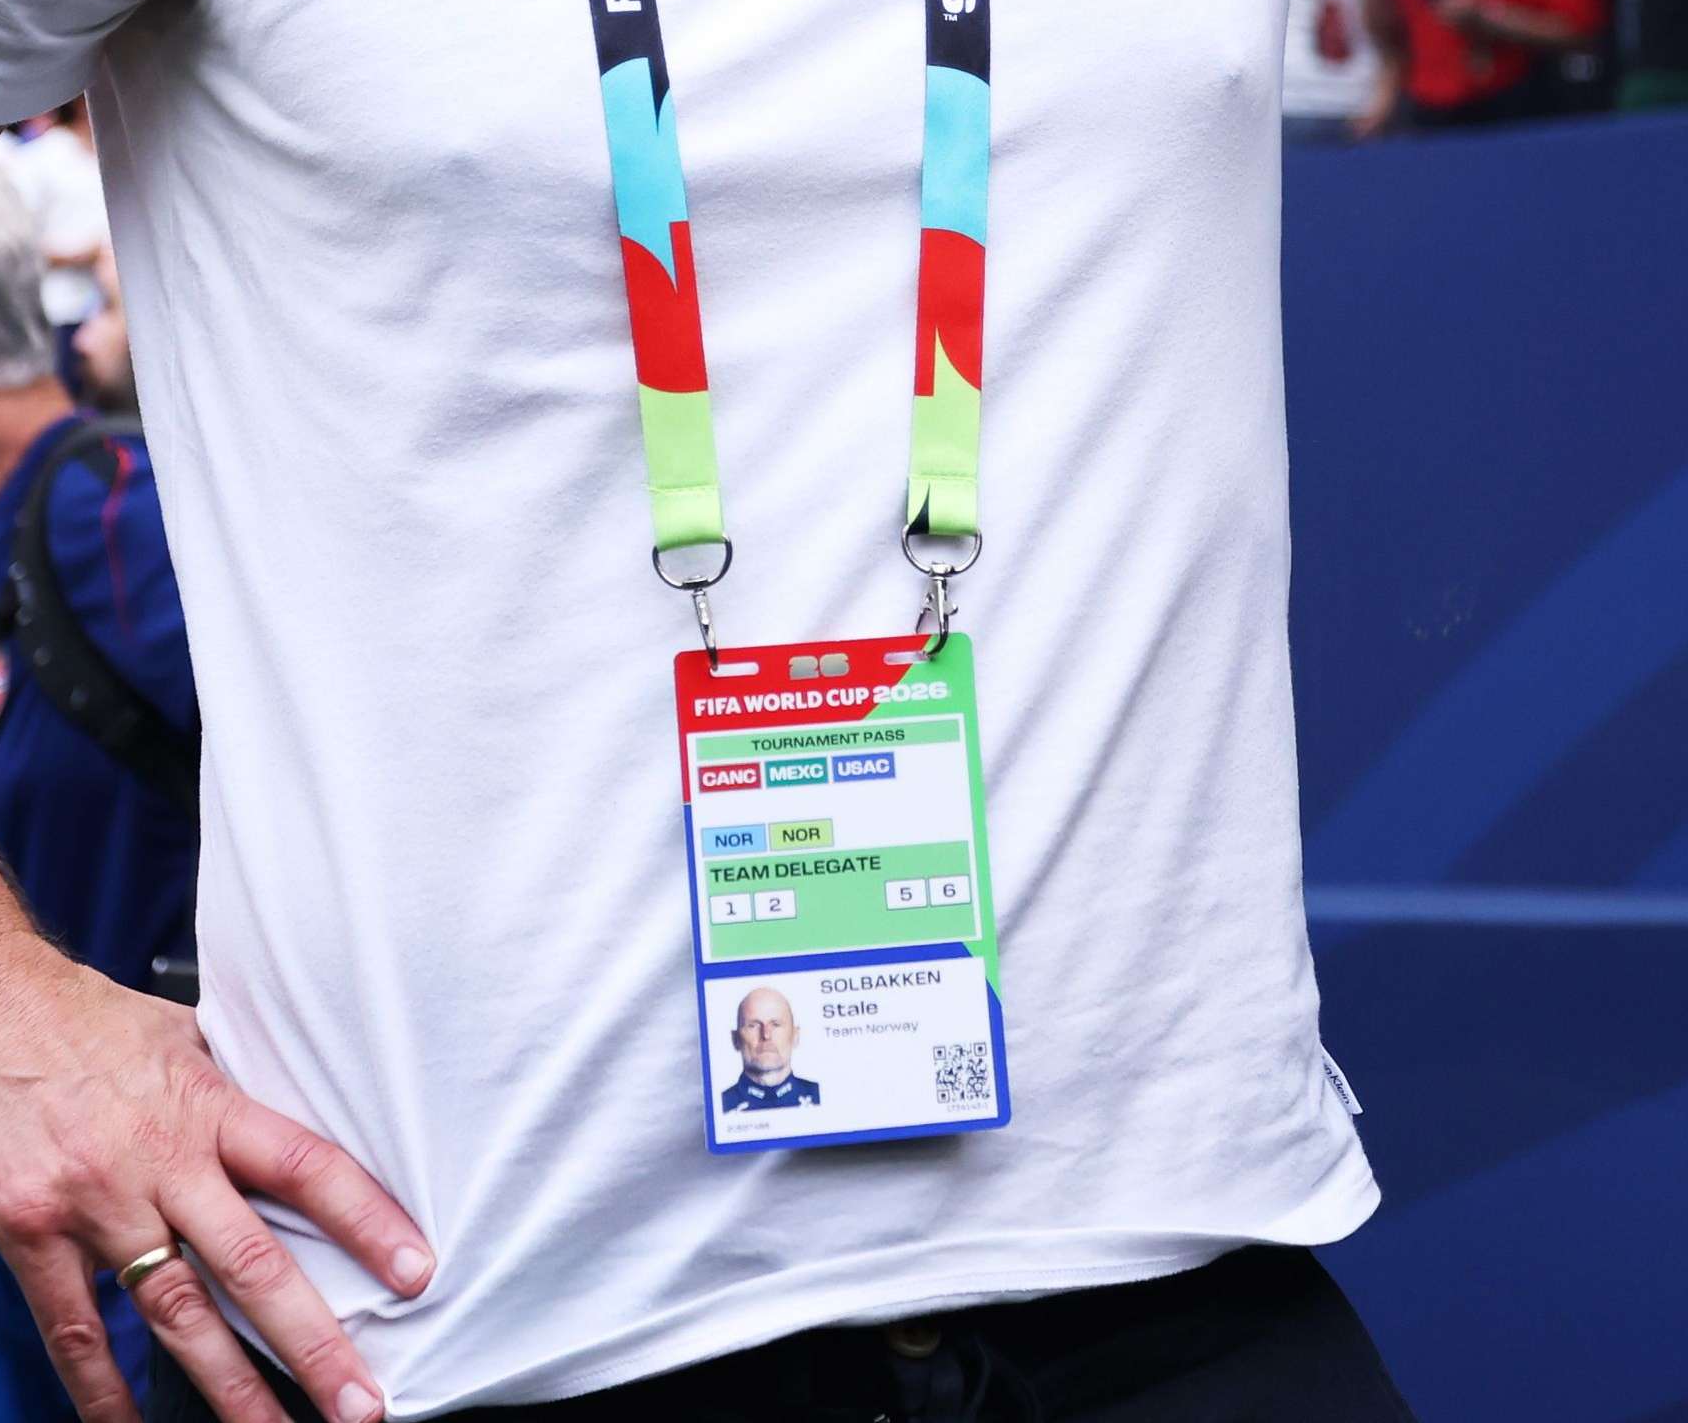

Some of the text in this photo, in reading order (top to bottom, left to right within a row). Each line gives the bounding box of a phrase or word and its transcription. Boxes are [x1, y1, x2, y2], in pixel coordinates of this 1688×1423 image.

[694, 681, 949, 717] FIFA WORLD CUP 2026
[751, 728, 905, 752] TOURNAMENT PASS
[702, 758, 891, 787] CANC MEXC USAC
[714, 827, 821, 848] NOR NOR
[711, 855, 882, 883] TEAM DELEGATE
[724, 882, 957, 916] 1 2 5 6
[820, 969, 942, 995] SOLBAKKEN
[822, 1001, 879, 1019] Stale
[824, 1020, 920, 1039] Team Norway
